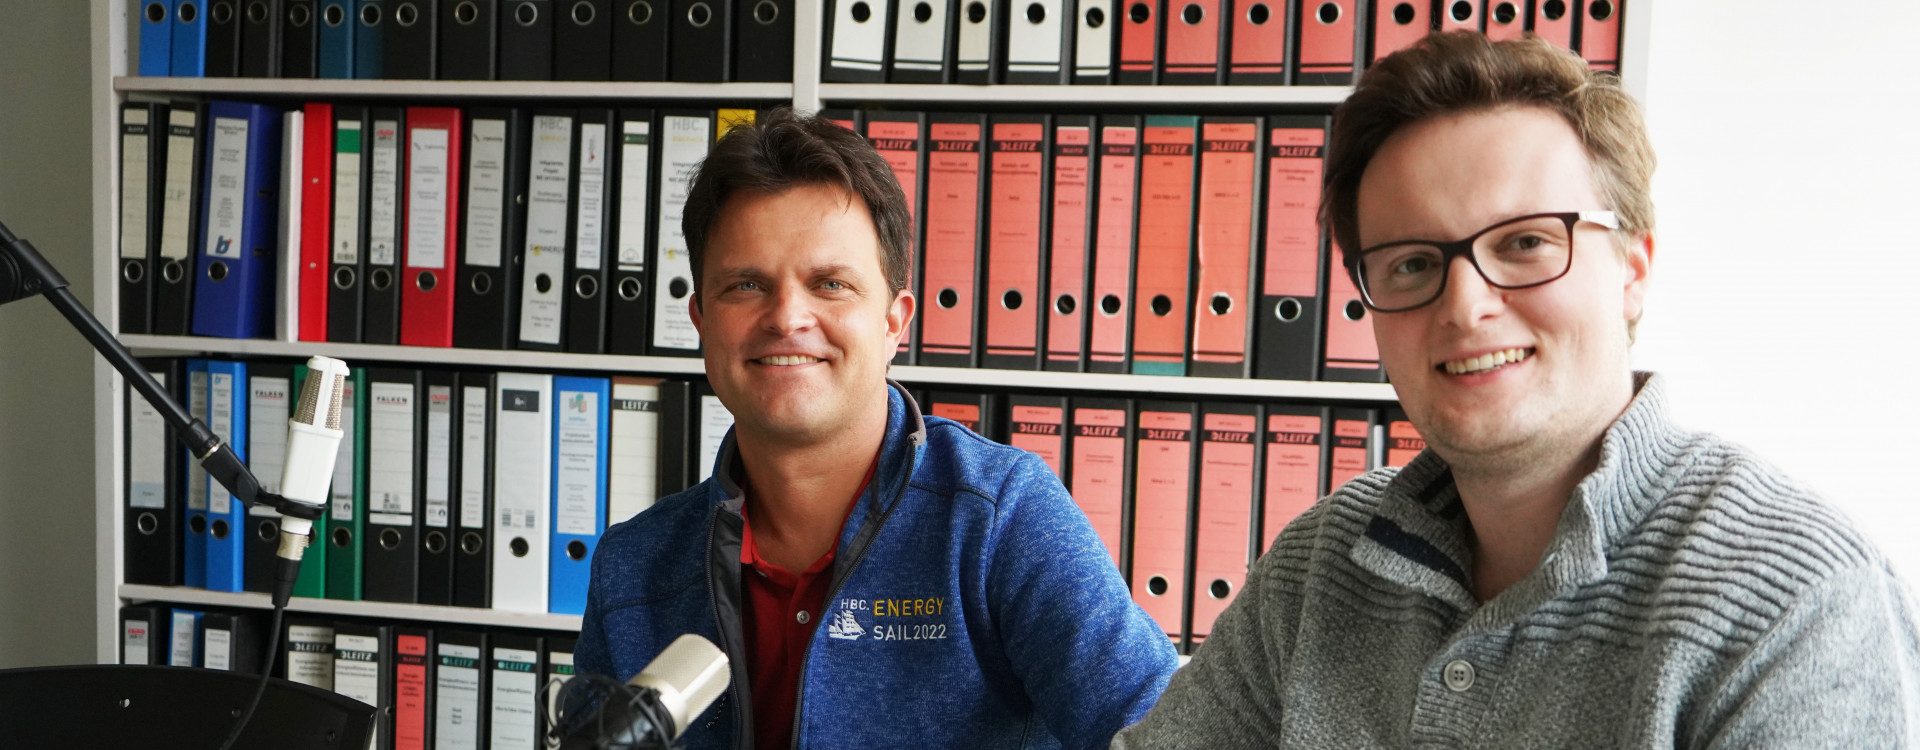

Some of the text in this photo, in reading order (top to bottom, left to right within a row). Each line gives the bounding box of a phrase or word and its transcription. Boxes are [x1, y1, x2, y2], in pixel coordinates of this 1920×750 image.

[883, 140, 912, 150] LEITZ
[945, 142, 974, 152] LEITZ
[1008, 142, 1037, 152] LEITZ
[1159, 145, 1188, 155] LEITZ
[1219, 141, 1249, 152] LEITZ
[1287, 147, 1319, 157] LEITZ
[255, 390, 284, 398] FALKEN
[377, 396, 408, 404] FALKEN
[622, 400, 649, 410] LEITZ
[1027, 424, 1057, 435] LEITZ
[1088, 427, 1119, 437] LEITZ
[1154, 430, 1185, 441] LEITZ
[1219, 432, 1250, 443] LEITZ
[1283, 433, 1314, 444] LEITZ
[840, 598, 870, 611] HBC.
[873, 597, 945, 617] ENERGY
[301, 642, 328, 653] LEITZ
[347, 650, 373, 661] LEITZ
[449, 657, 475, 668] LEITZ
[505, 661, 532, 673] LEITZ
